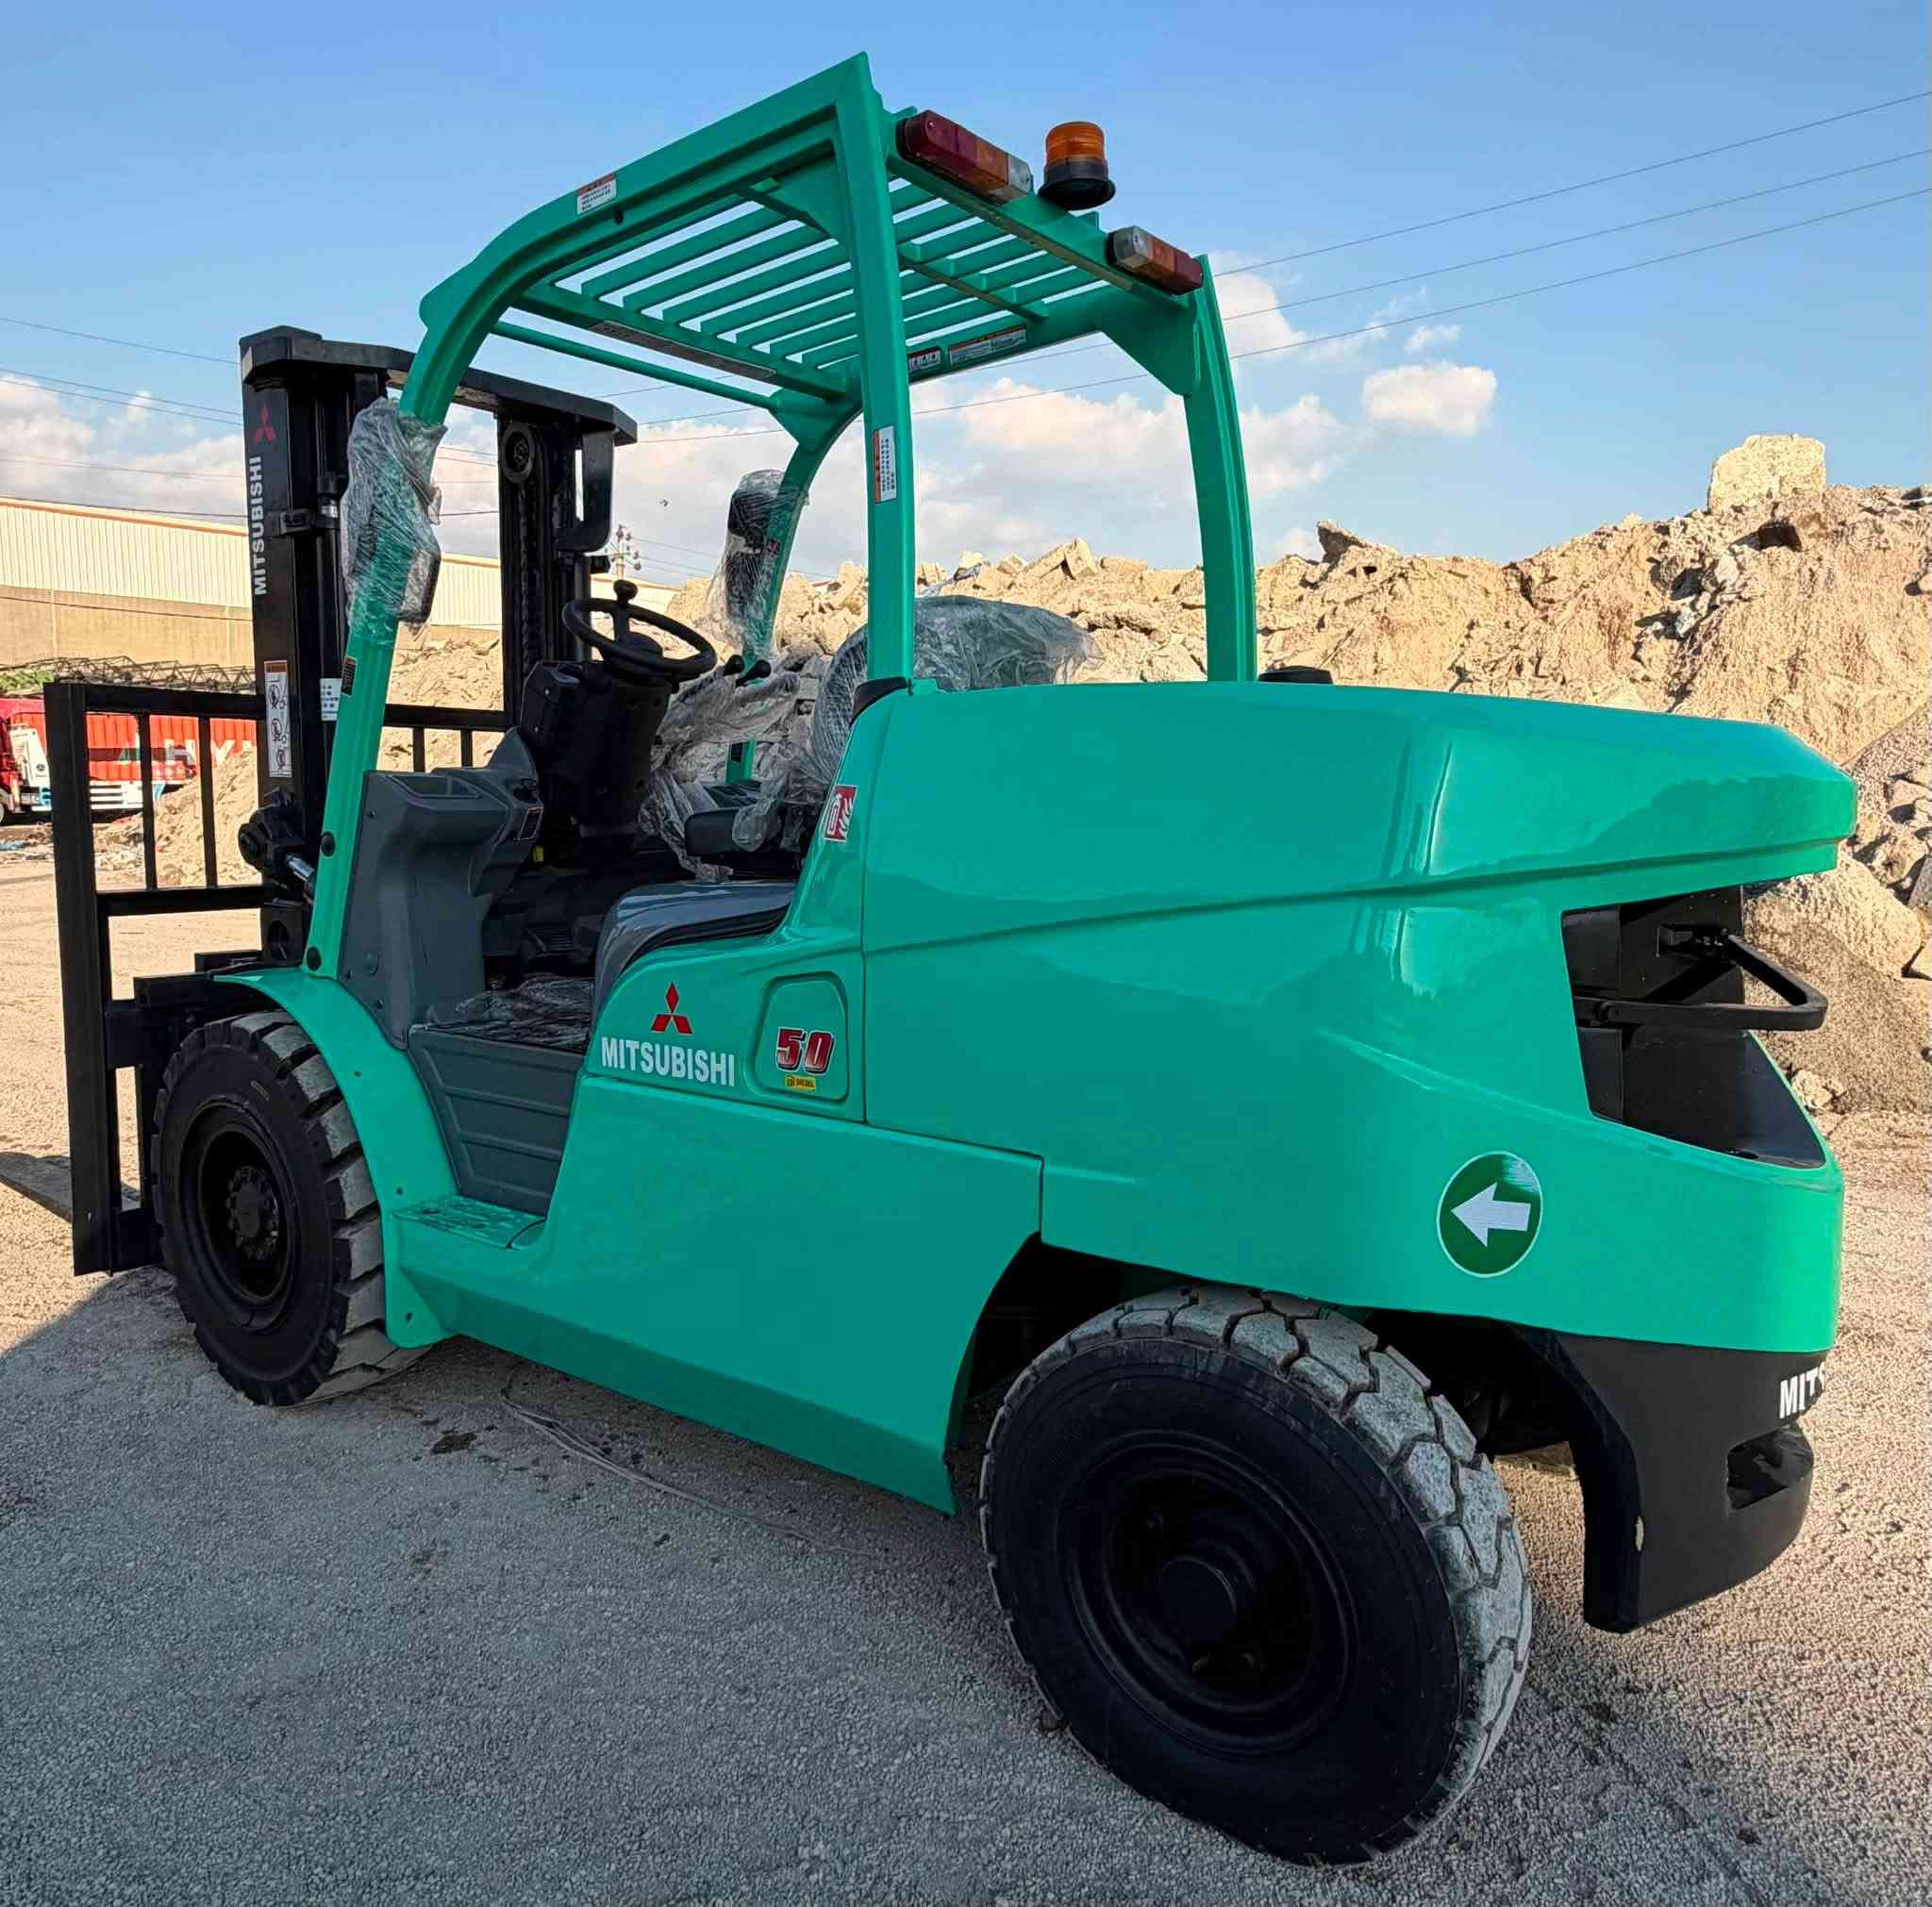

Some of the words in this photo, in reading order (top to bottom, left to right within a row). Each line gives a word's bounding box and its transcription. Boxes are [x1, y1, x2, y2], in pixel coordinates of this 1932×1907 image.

[249, 456, 267, 595] MITSUBISHI
[601, 1036, 735, 1087] MITSUBISHI
[775, 1026, 835, 1076] 50
